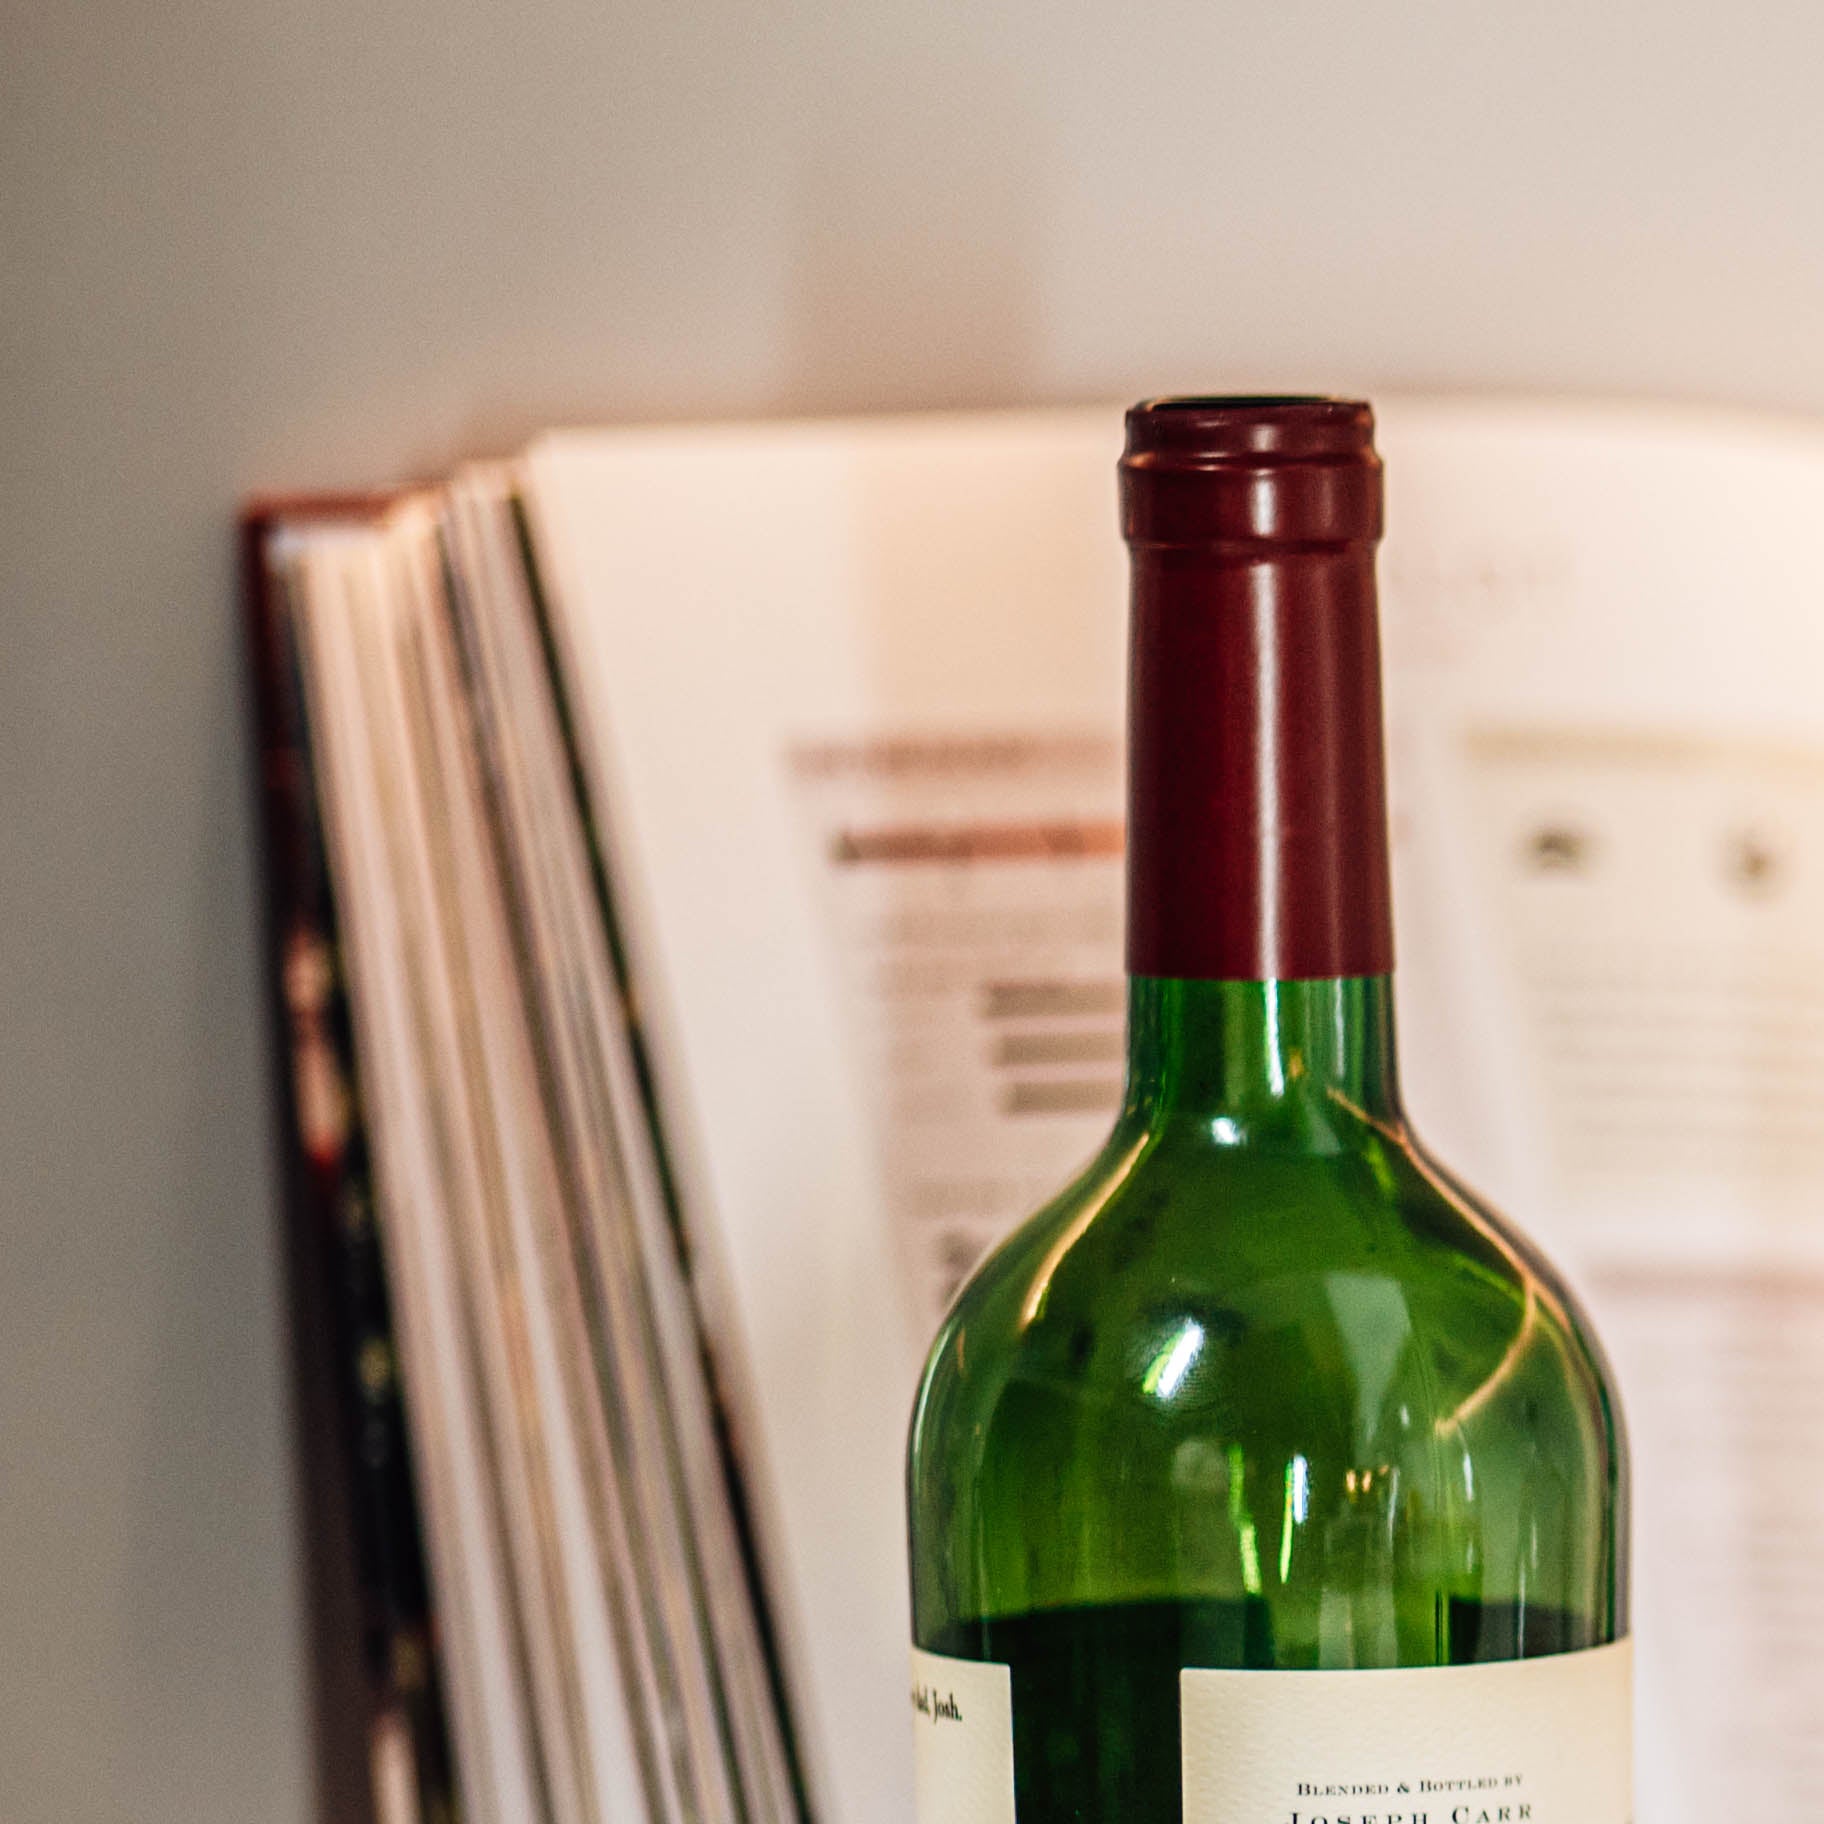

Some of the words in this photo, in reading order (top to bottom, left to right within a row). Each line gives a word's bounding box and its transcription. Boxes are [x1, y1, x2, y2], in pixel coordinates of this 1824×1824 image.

[932, 1687, 963, 1724] Josh.
[1296, 1782, 1390, 1797] BLENDED
[1396, 1781, 1411, 1795] &
[1419, 1777, 1499, 1794] BOTTLED
[1503, 1773, 1524, 1788] BY
